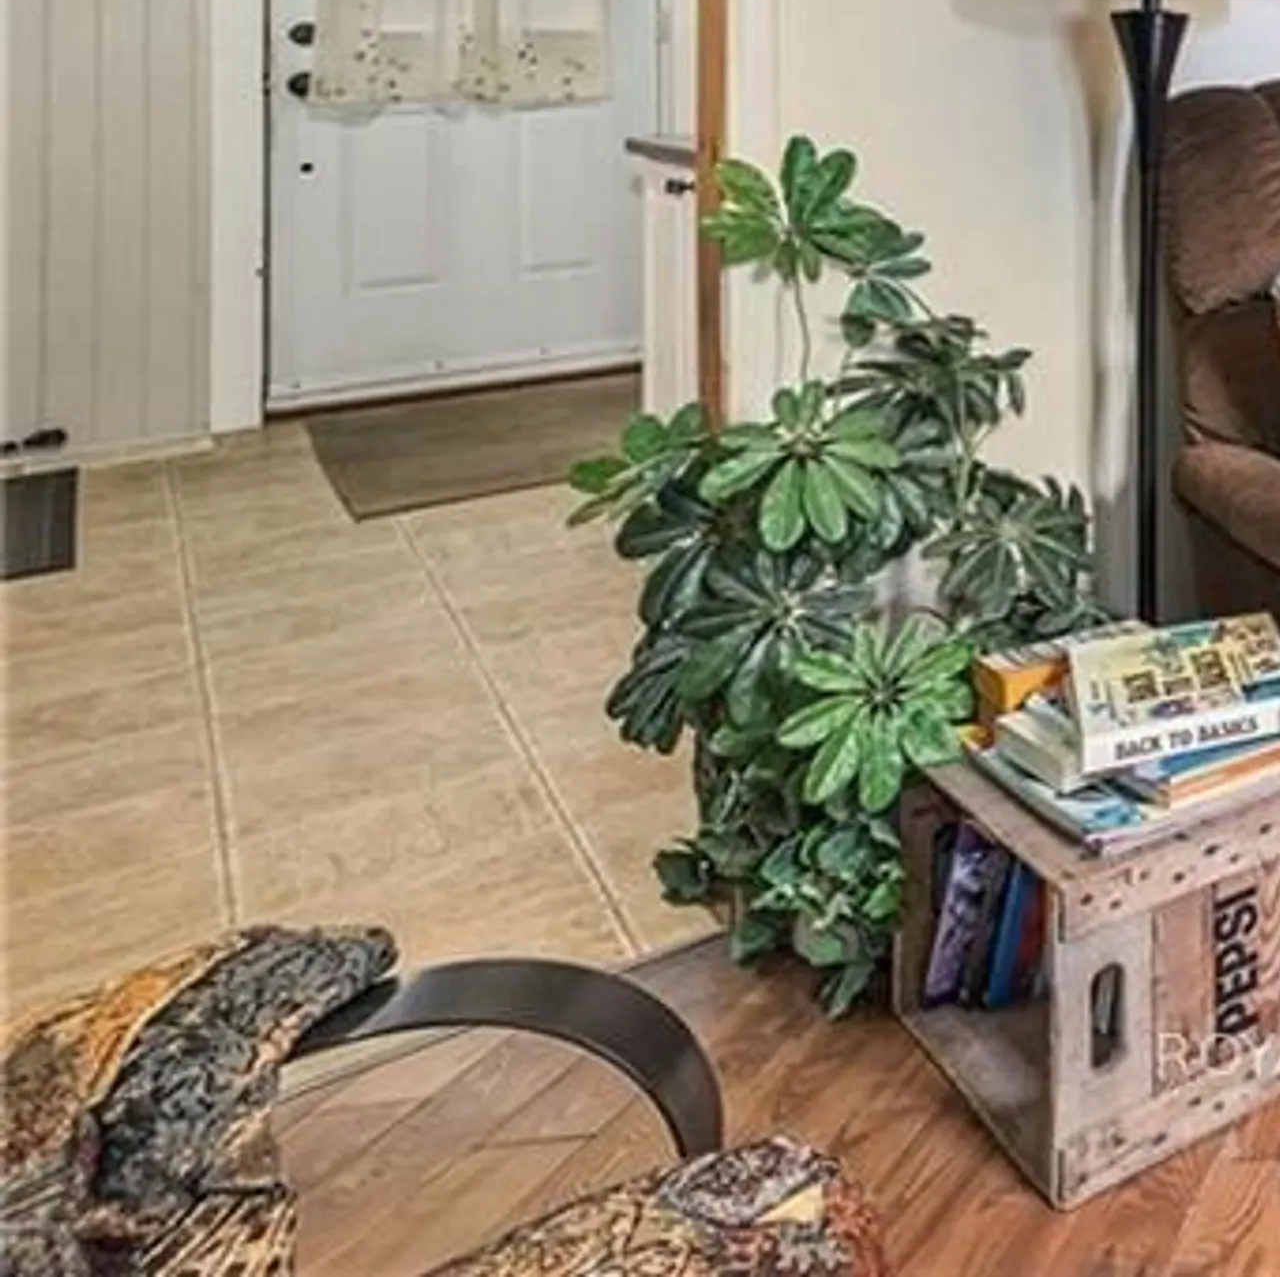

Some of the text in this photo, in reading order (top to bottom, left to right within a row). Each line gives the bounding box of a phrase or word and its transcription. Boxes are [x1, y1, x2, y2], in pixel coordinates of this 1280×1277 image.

[1113, 714, 1258, 761] BACK TO BASICS
[1214, 886, 1260, 1035] PEPSI
